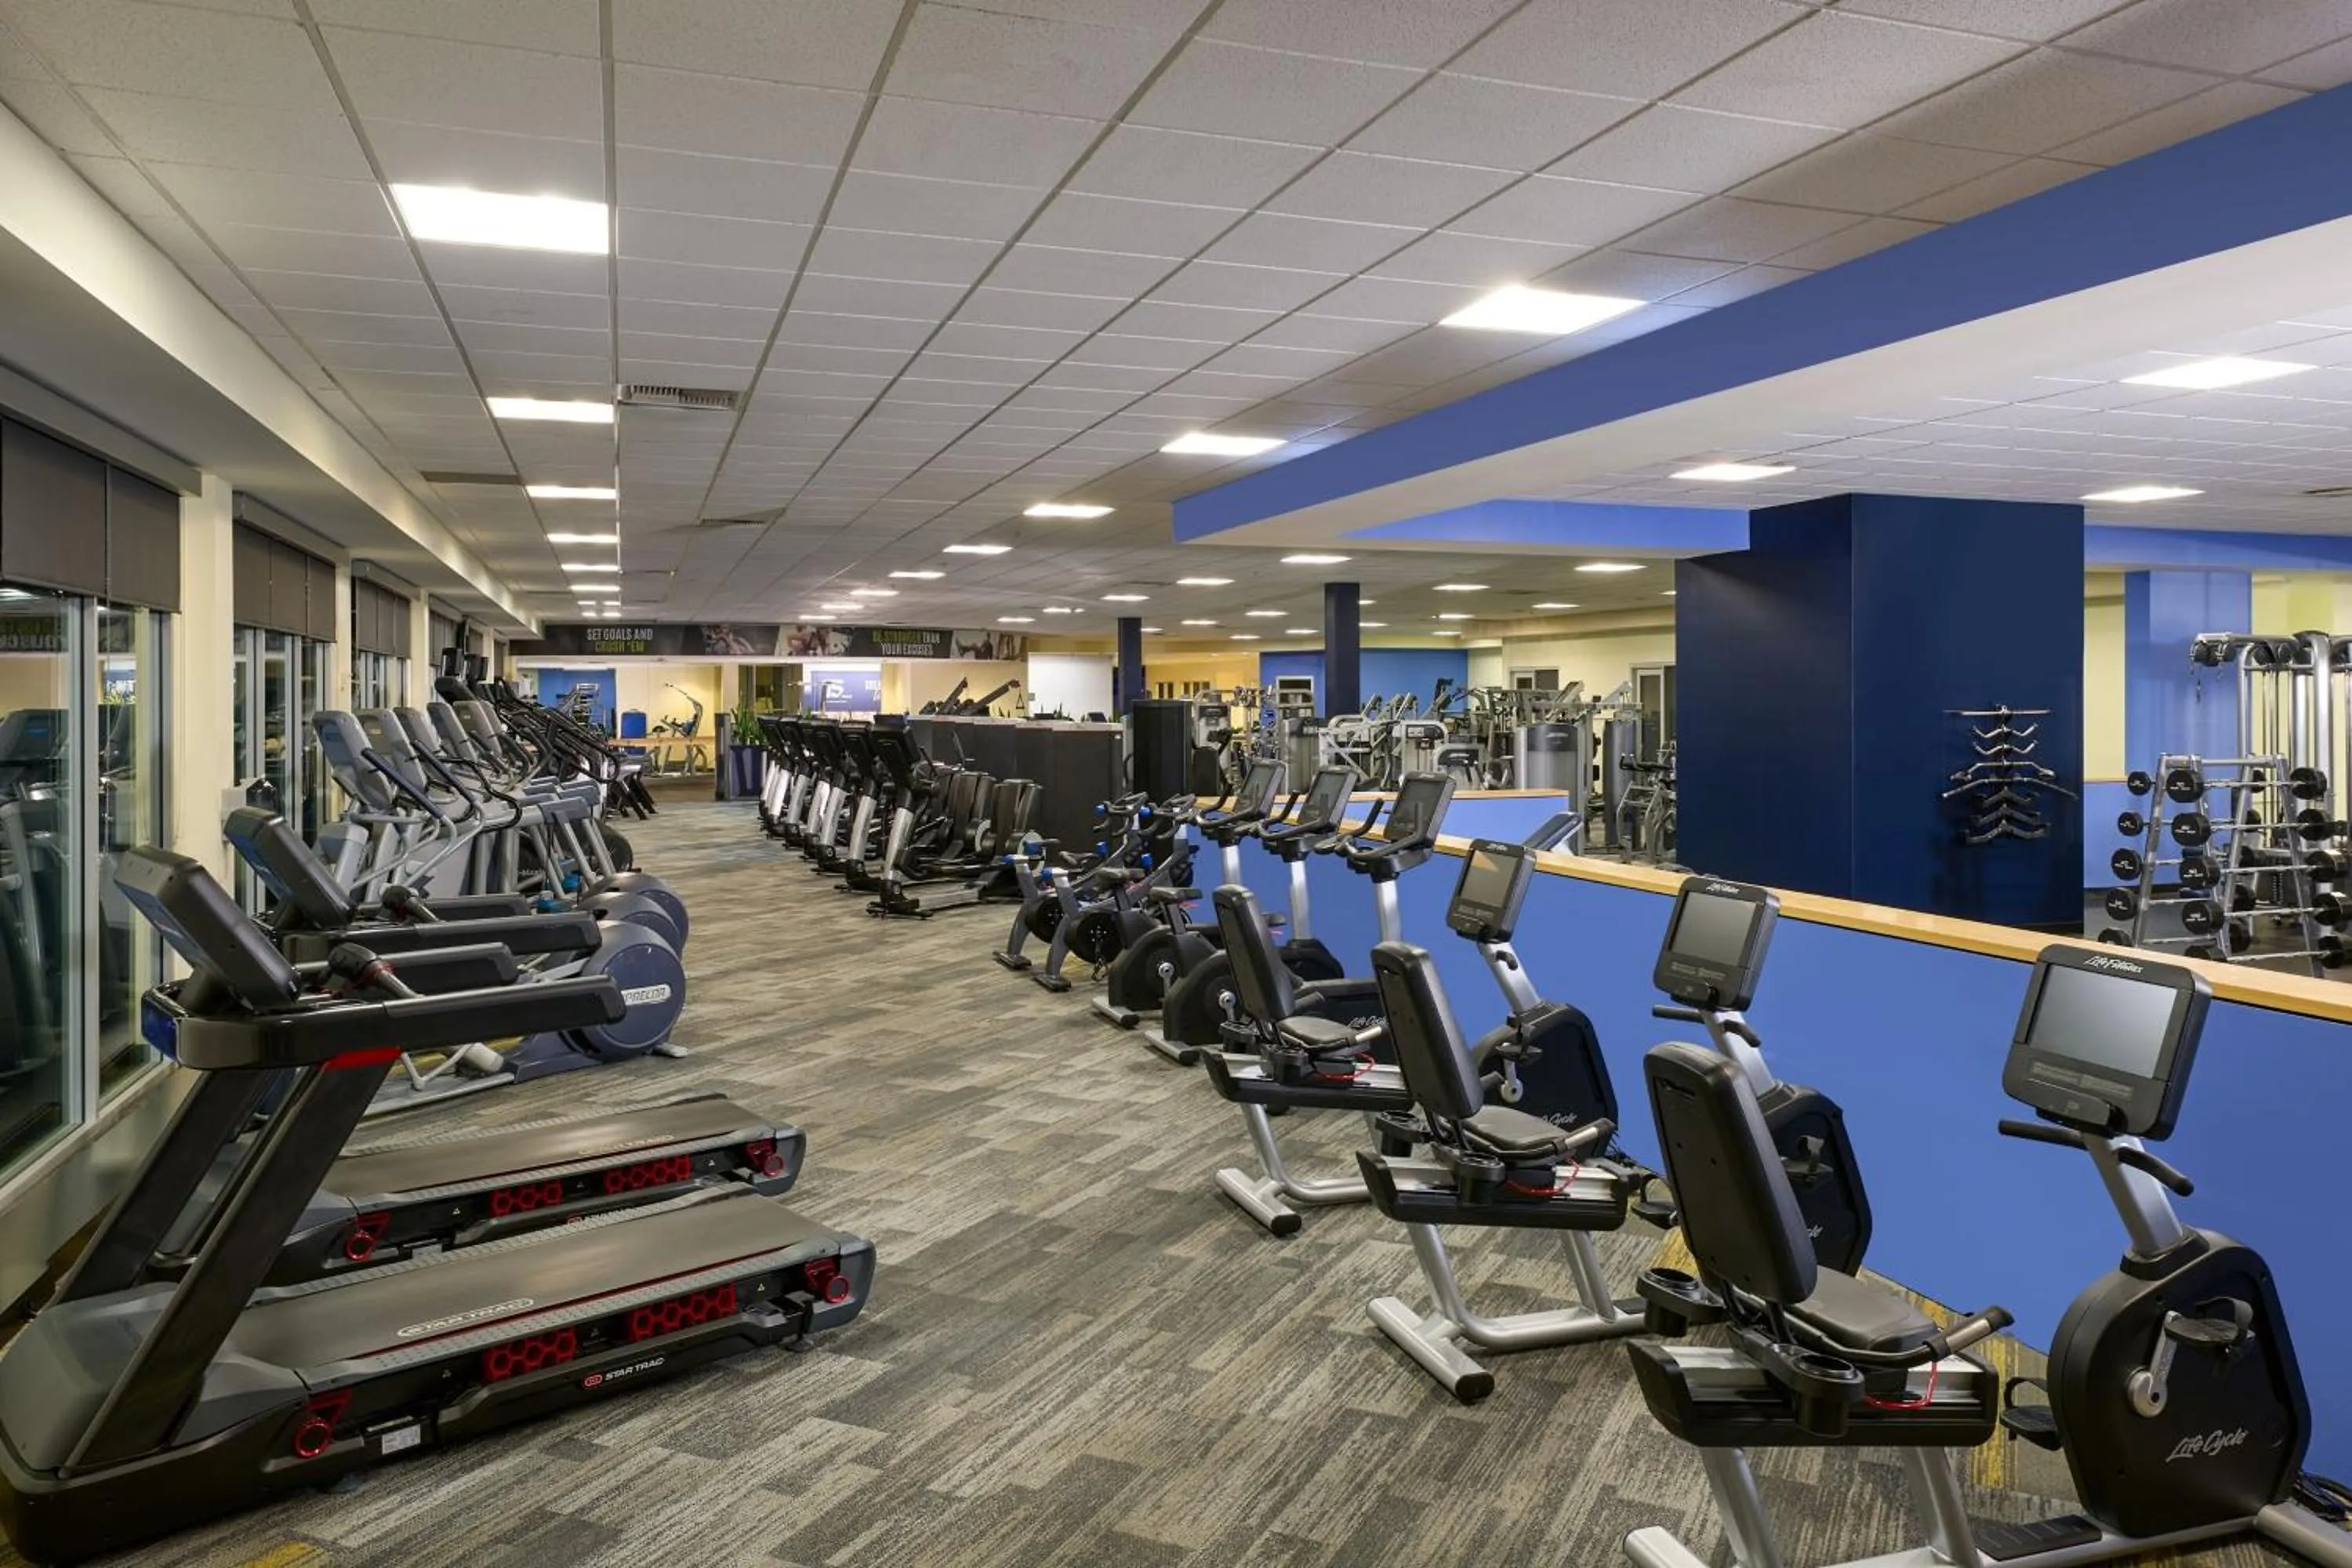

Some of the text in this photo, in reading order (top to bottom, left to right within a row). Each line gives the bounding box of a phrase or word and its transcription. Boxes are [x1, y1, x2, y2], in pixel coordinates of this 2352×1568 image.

[586, 628, 653, 641] SET GOALS AND
[605, 1357, 666, 1381] STAR TRAC
